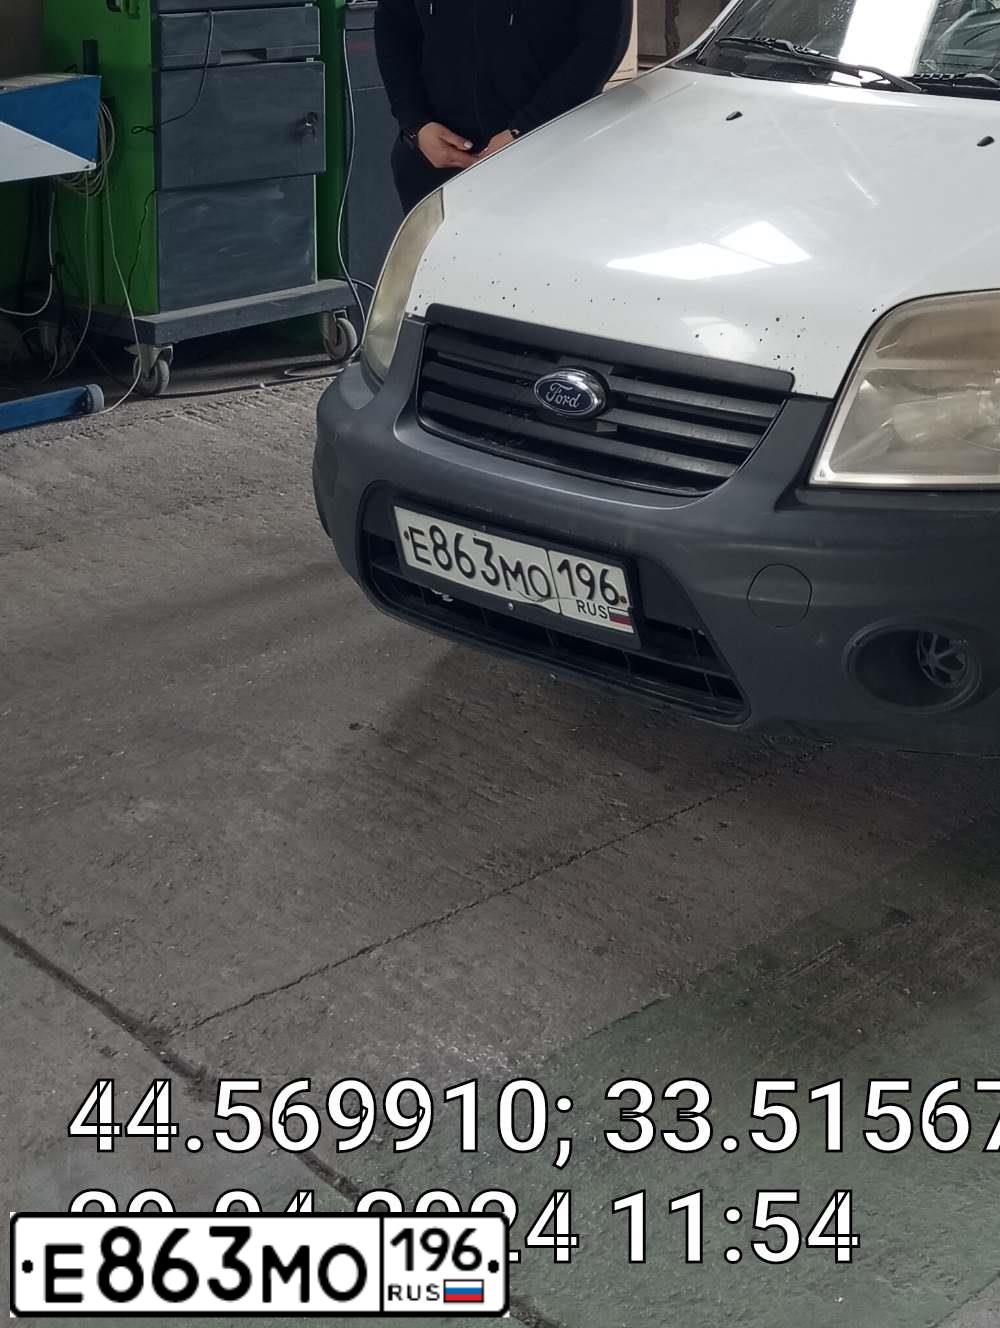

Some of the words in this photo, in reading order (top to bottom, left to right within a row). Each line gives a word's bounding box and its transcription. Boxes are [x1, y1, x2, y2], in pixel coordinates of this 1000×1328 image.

[546, 382, 581, 408] Ford
[557, 558, 620, 606] 196
[576, 599, 609, 619] RUS
